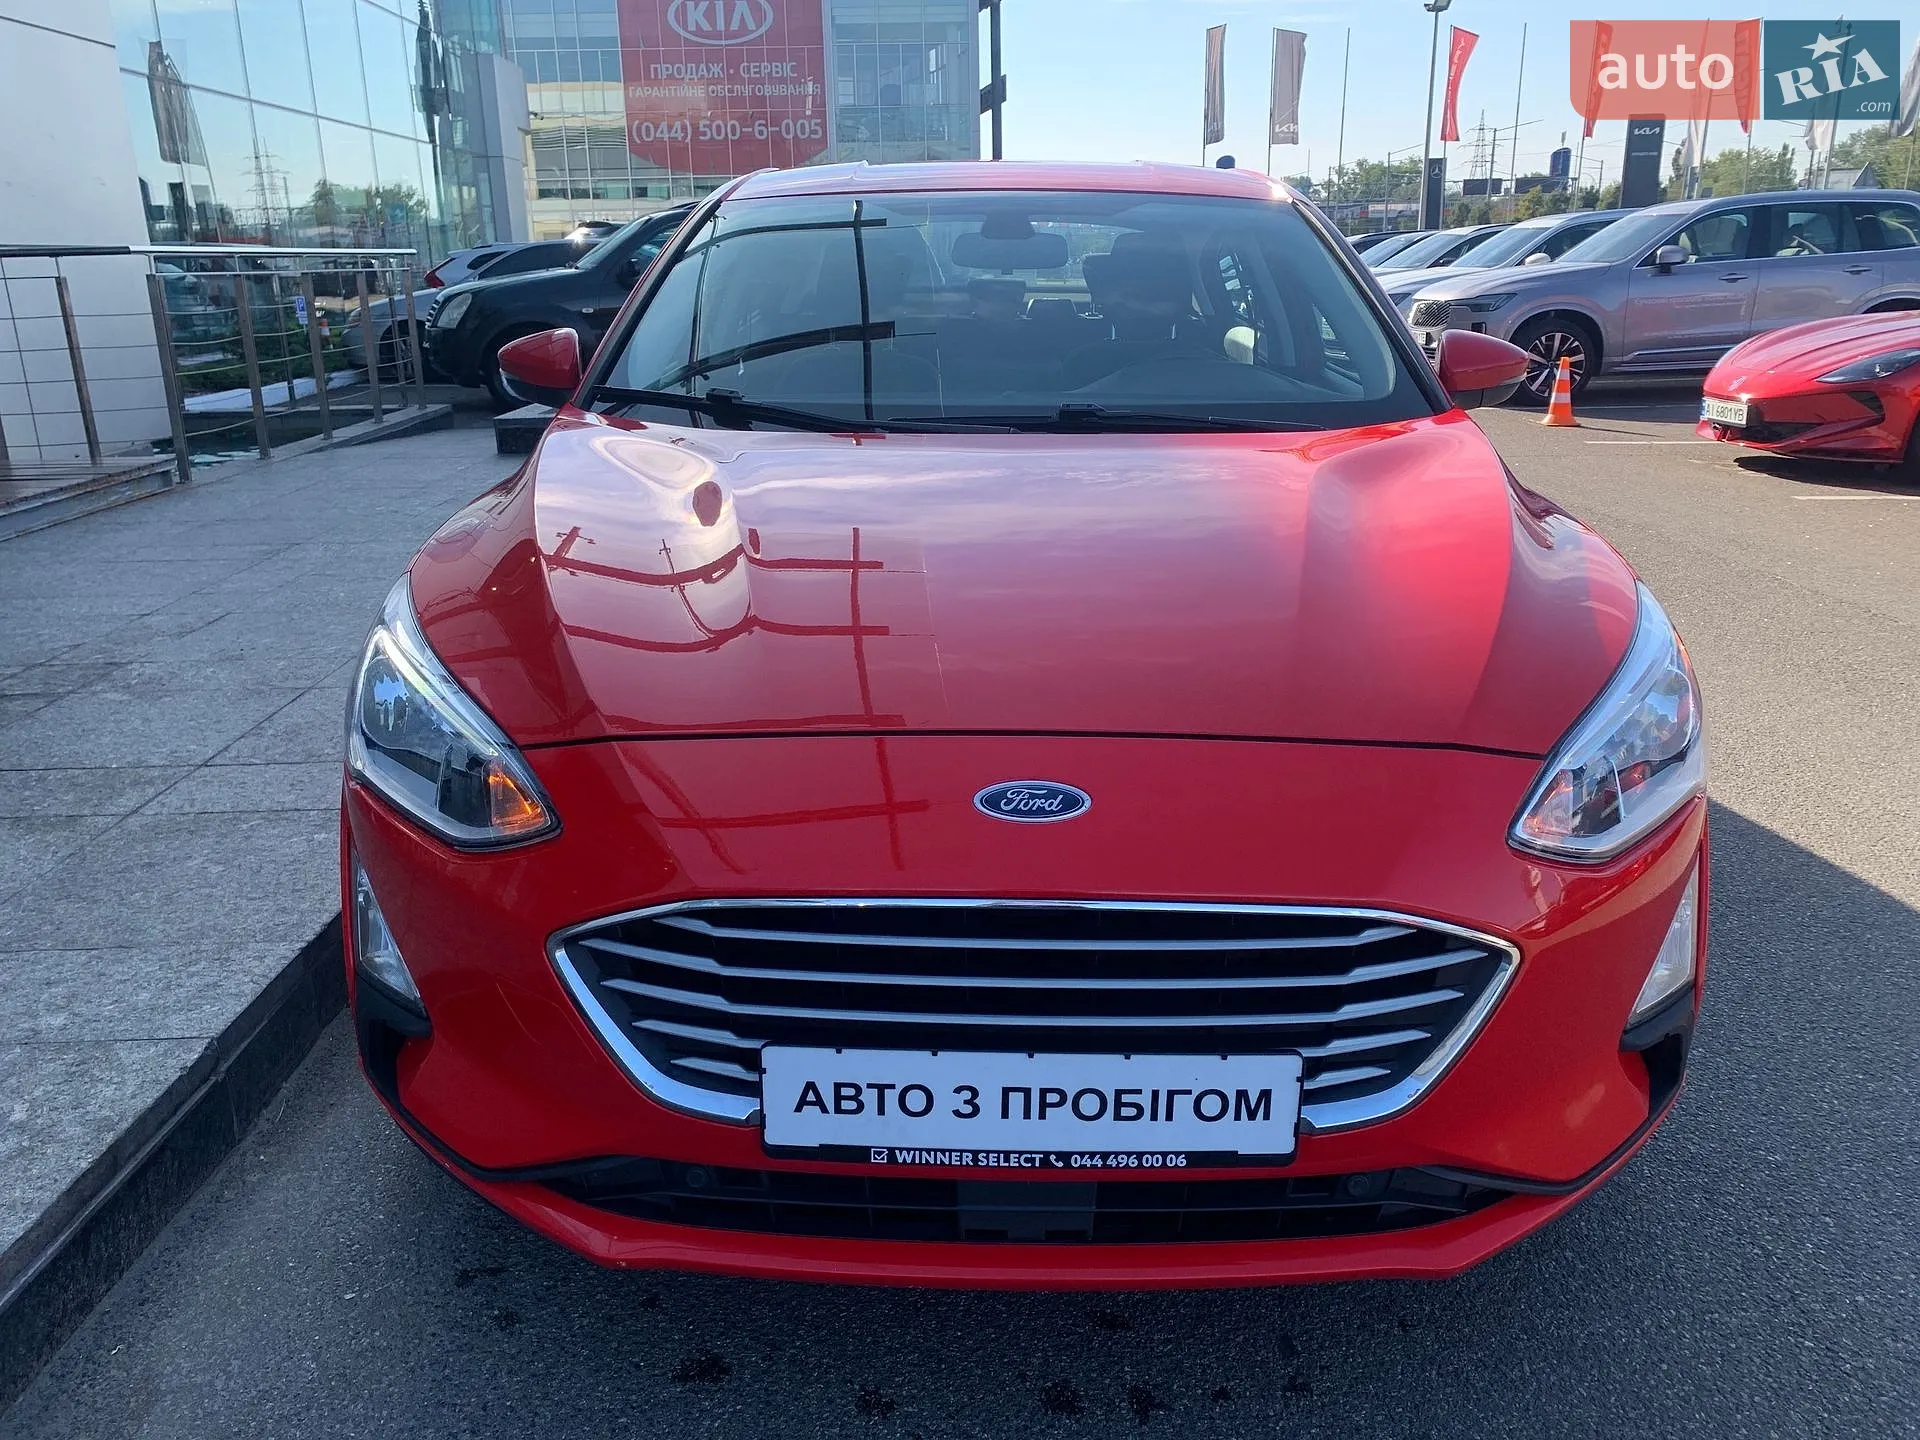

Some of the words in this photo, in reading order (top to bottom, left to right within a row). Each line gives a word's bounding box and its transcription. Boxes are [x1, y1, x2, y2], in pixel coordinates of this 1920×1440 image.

[687, 0, 757, 32] KIA
[650, 63, 724, 81] ПРОДАЖ
[740, 62, 798, 77] СЕРВІС
[629, 83, 706, 98] ГАРАНТІЙНЕ
[709, 83, 821, 97] ОБСЛУГОВУВАННЯ
[632, 119, 693, 143] (044)
[699, 119, 823, 141] 500-6-005
[1000, 788, 1064, 811] Ford
[793, 1080, 935, 1118] АВТО
[1001, 1086, 1273, 1122] ПРОБІГОМ
[895, 1149, 974, 1166] WINNER
[978, 1152, 1044, 1167] SELECT
[1071, 1154, 1103, 1168] 044
[1106, 1154, 1139, 1168] 496
[1142, 1154, 1158, 1168] 00
[1166, 1154, 1187, 1168] 06
